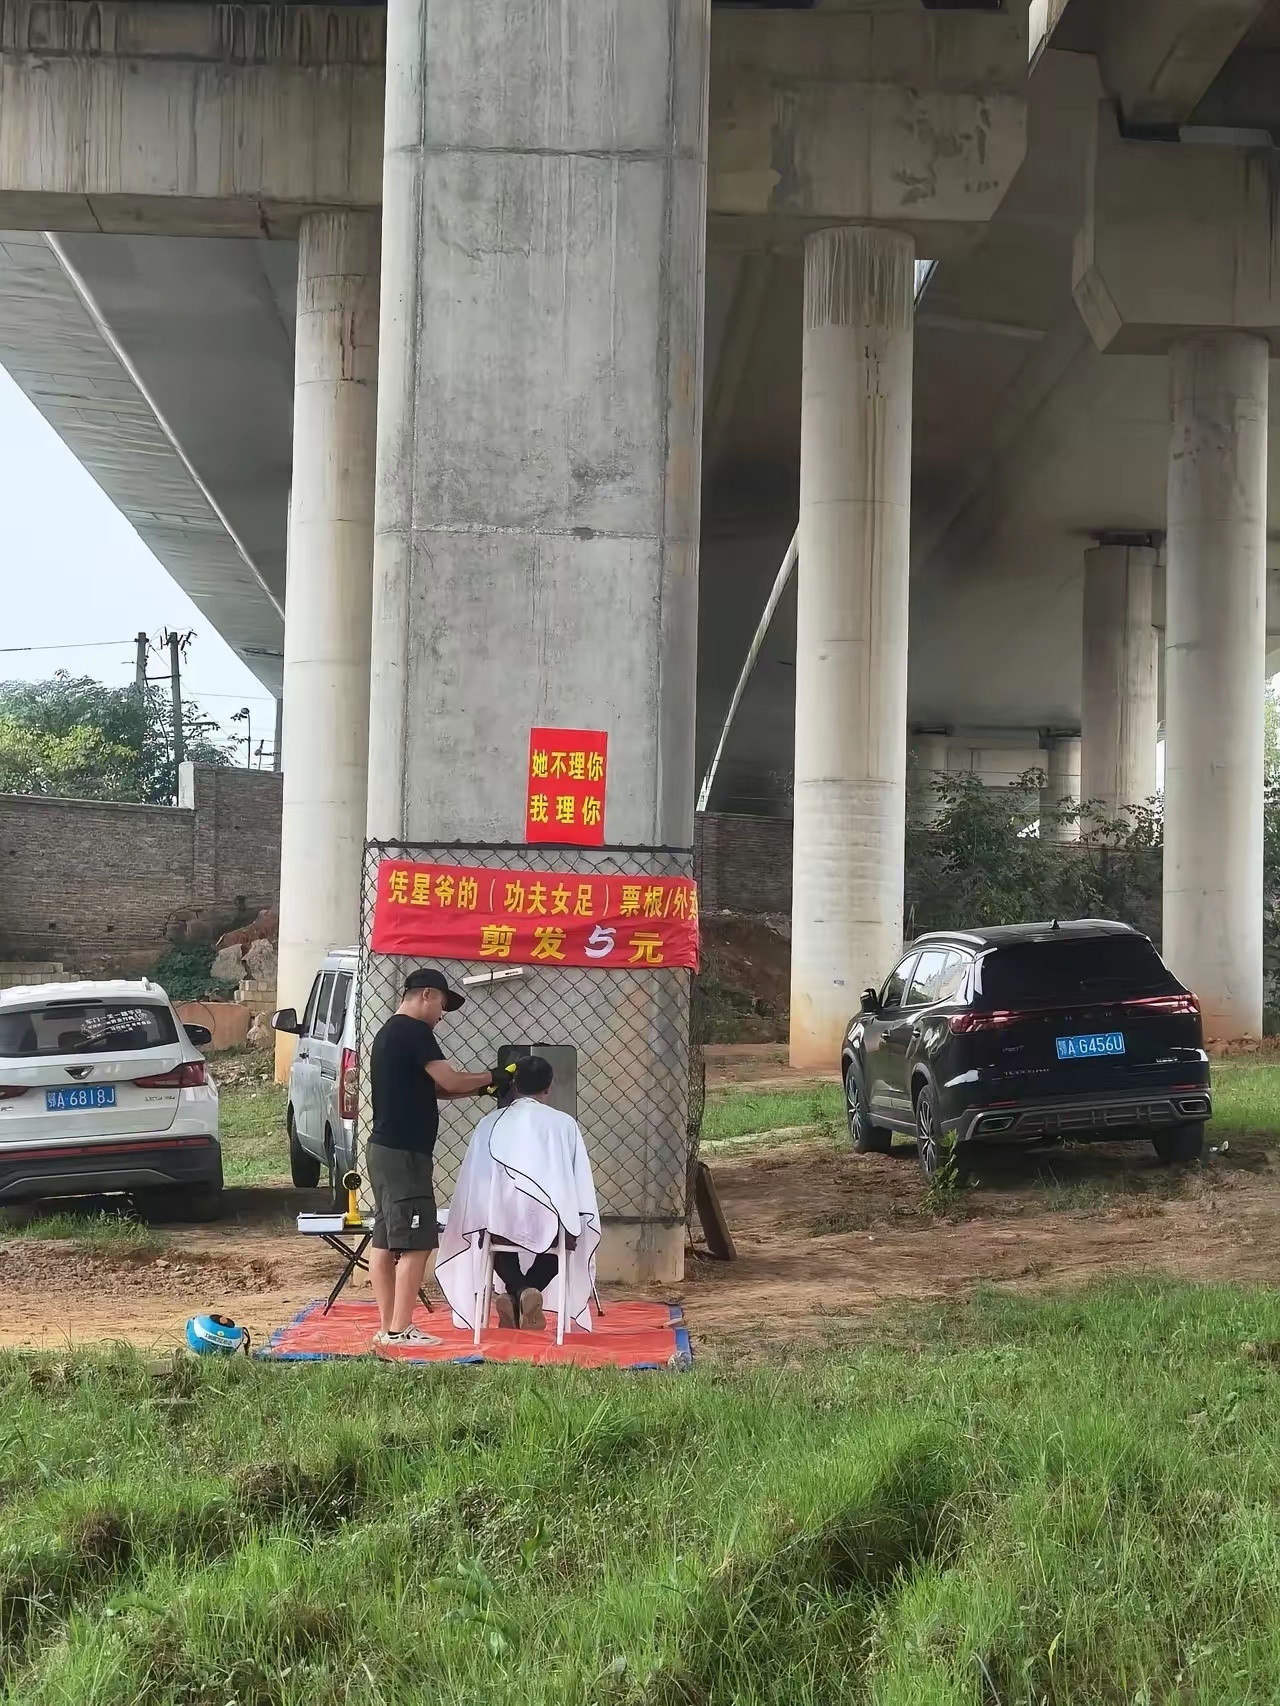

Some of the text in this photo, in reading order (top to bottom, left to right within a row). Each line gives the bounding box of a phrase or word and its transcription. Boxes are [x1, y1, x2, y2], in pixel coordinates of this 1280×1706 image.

[532, 750, 604, 781] 她不理你
[529, 794, 602, 826] 我理你
[479, 924, 664, 963] 剪发5元
